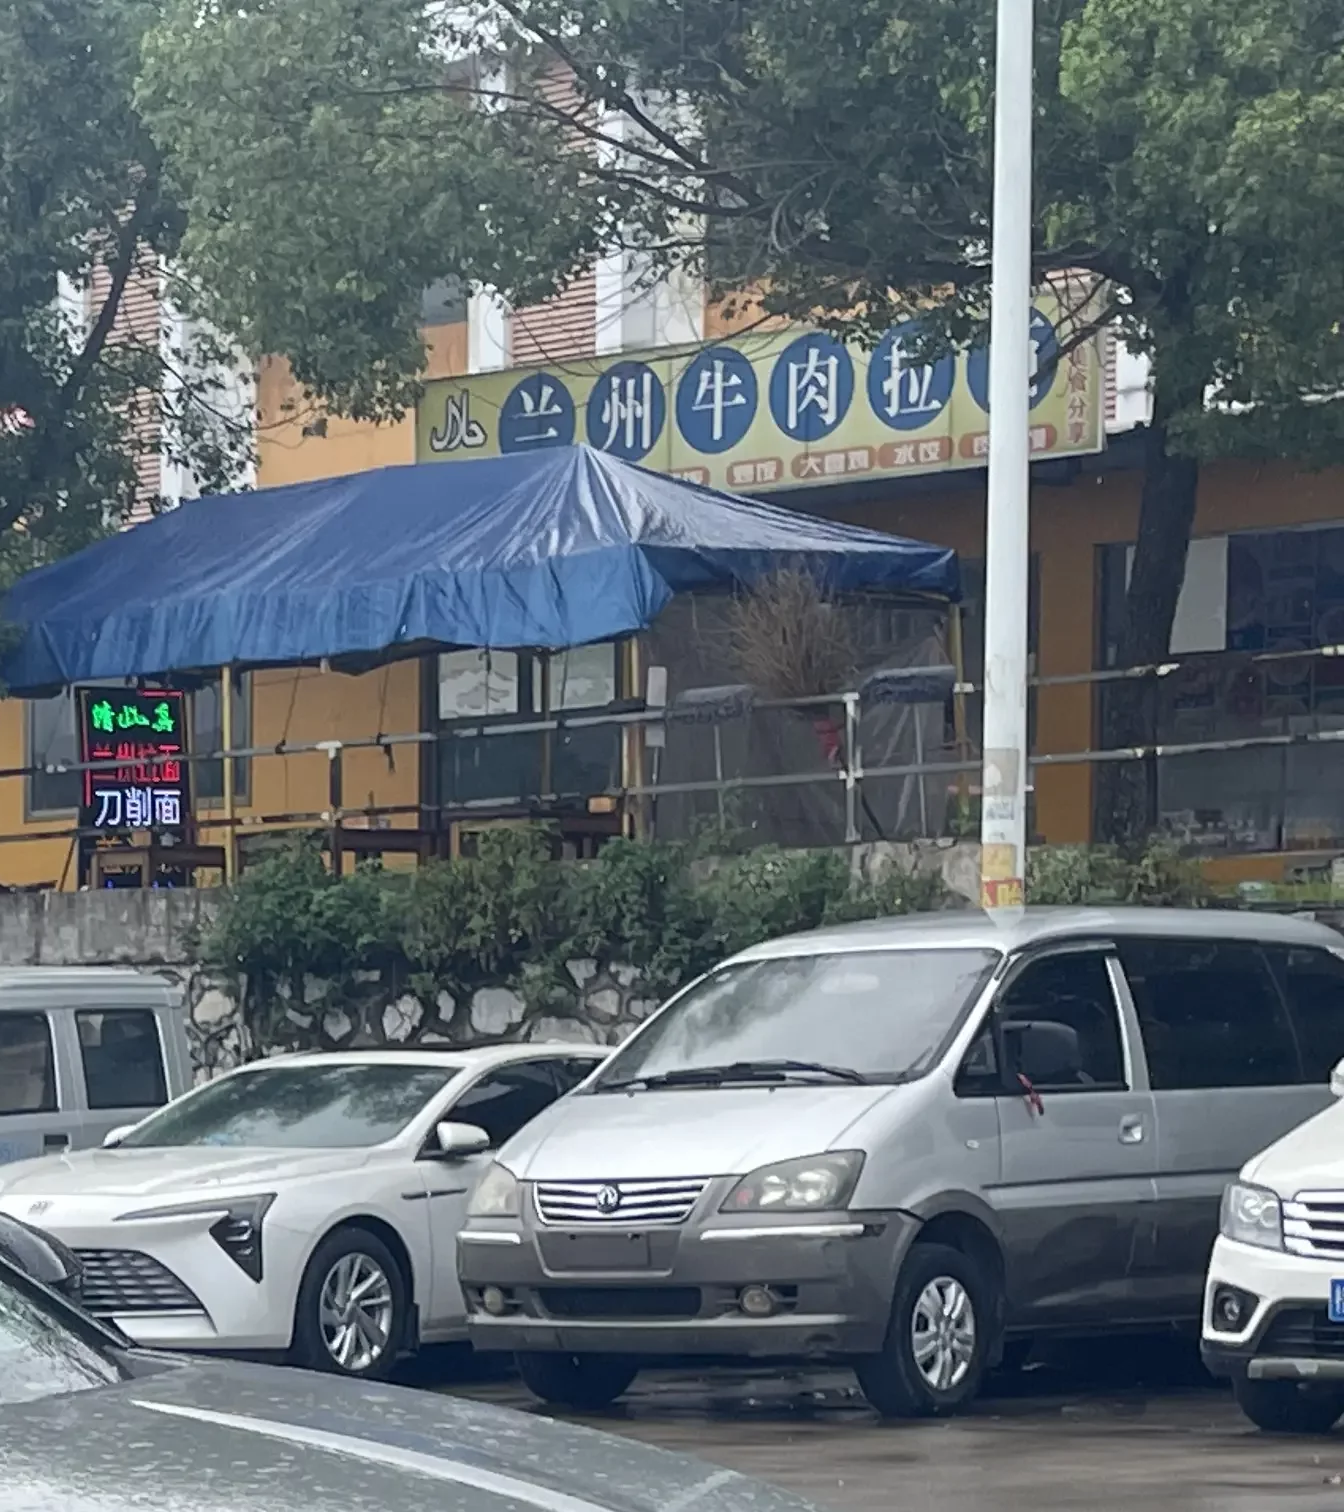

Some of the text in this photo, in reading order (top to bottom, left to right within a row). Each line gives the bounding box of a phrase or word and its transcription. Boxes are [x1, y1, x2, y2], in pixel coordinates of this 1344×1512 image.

[509, 317, 1041, 451] 兰州牛肉拉
[429, 388, 489, 453] حلال
[94, 786, 182, 828] 刀削面
